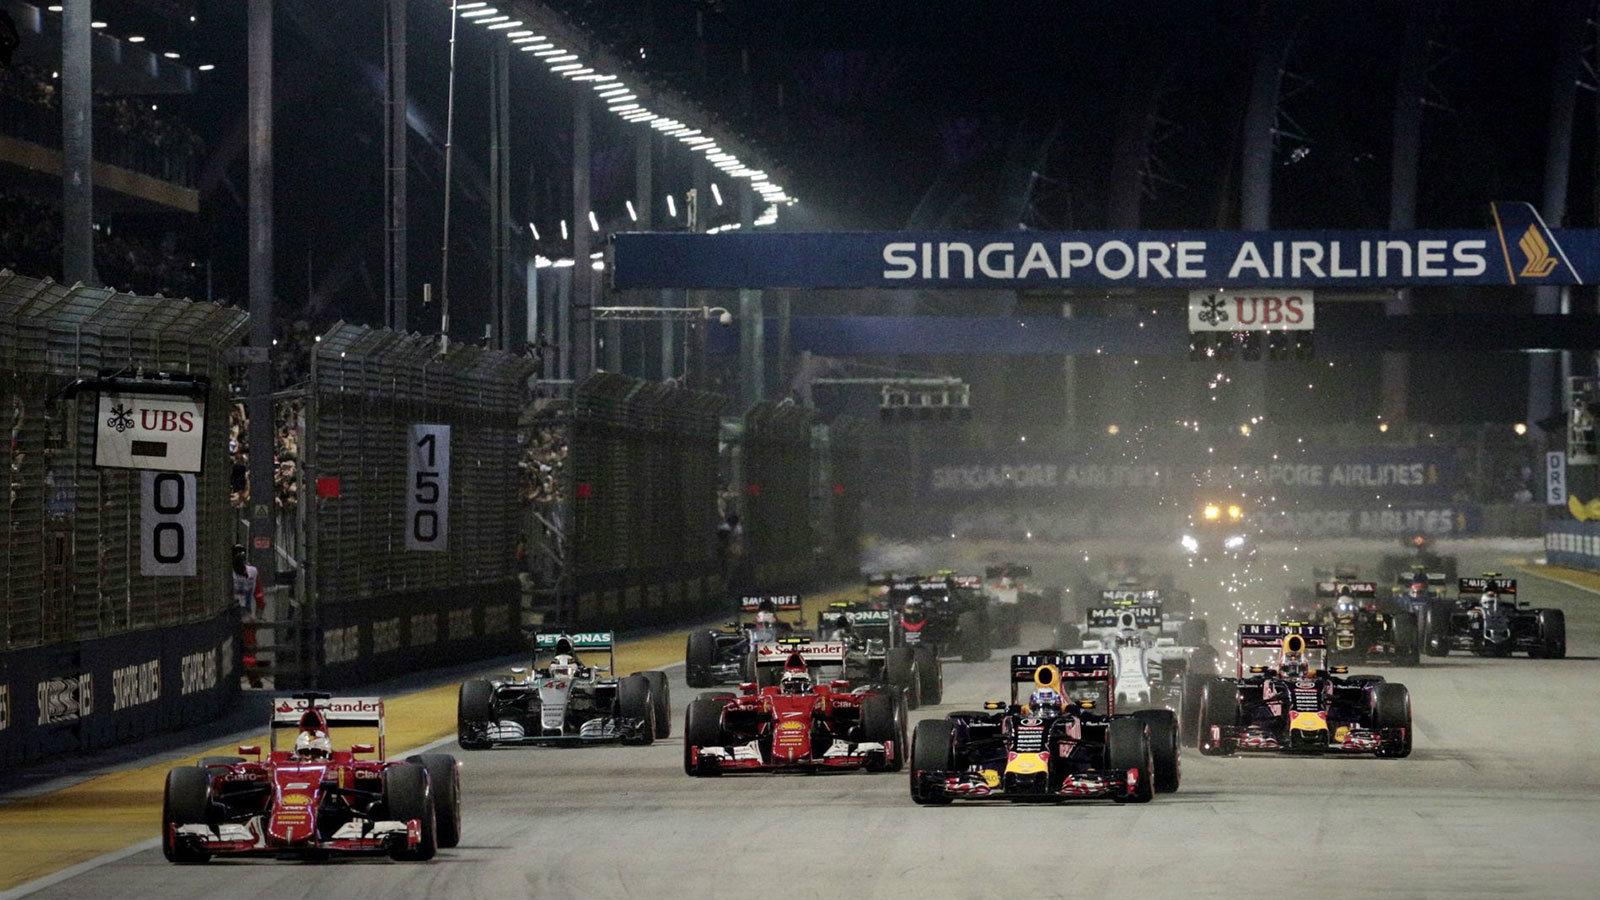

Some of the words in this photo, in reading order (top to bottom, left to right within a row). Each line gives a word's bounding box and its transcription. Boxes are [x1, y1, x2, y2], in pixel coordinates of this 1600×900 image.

[883, 240, 1206, 280] SINGAPORE
[1228, 240, 1487, 279] AIRLINES
[1236, 296, 1304, 324] UBS
[140, 409, 194, 432] UBS
[1550, 455, 1561, 500] DRS
[414, 434, 439, 542] 150
[1462, 579, 1511, 588] SMIRFF
[743, 596, 798, 606] SMINOFF
[823, 611, 888, 620] PEONAS
[1242, 625, 1323, 634] INFINITI
[536, 633, 611, 643] PETONAS
[1017, 655, 1109, 666] ININITI
[297, 700, 379, 712] Stander
[355, 770, 383, 779] Clar
